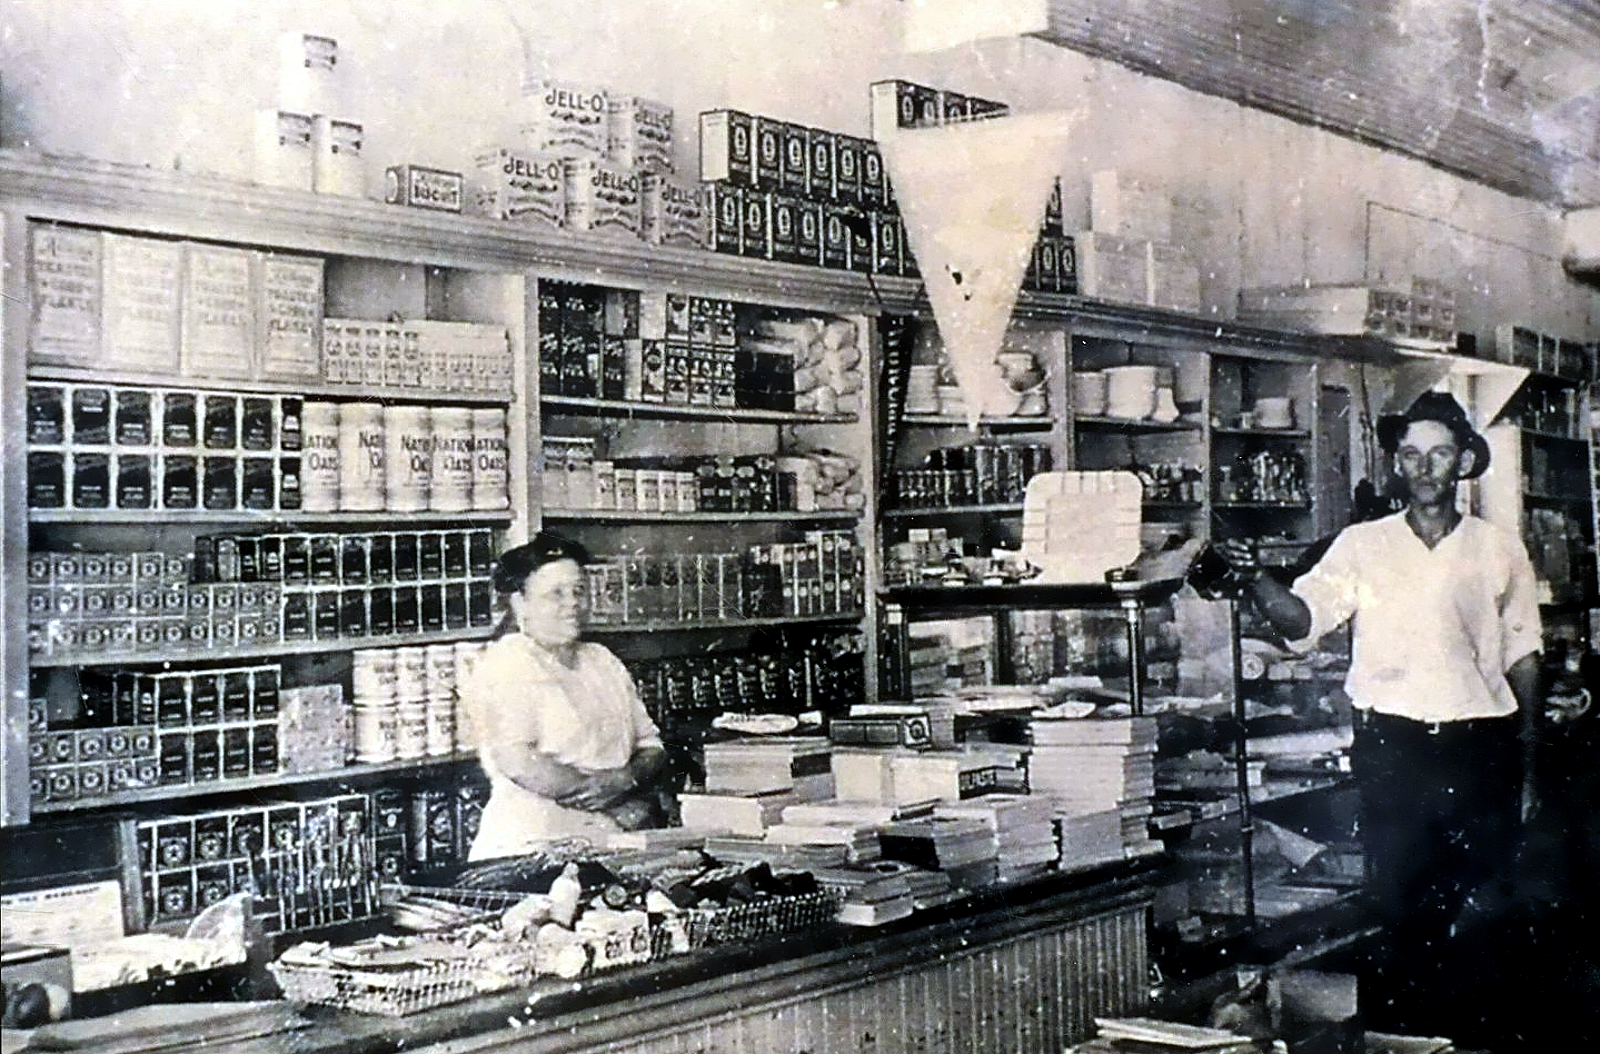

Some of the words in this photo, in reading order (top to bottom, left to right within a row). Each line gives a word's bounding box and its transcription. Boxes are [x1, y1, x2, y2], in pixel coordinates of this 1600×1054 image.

[544, 89, 604, 112] JELL-O
[503, 157, 559, 181] JELL-O
[590, 170, 640, 193] JELL-O
[661, 184, 704, 206] JELL-O
